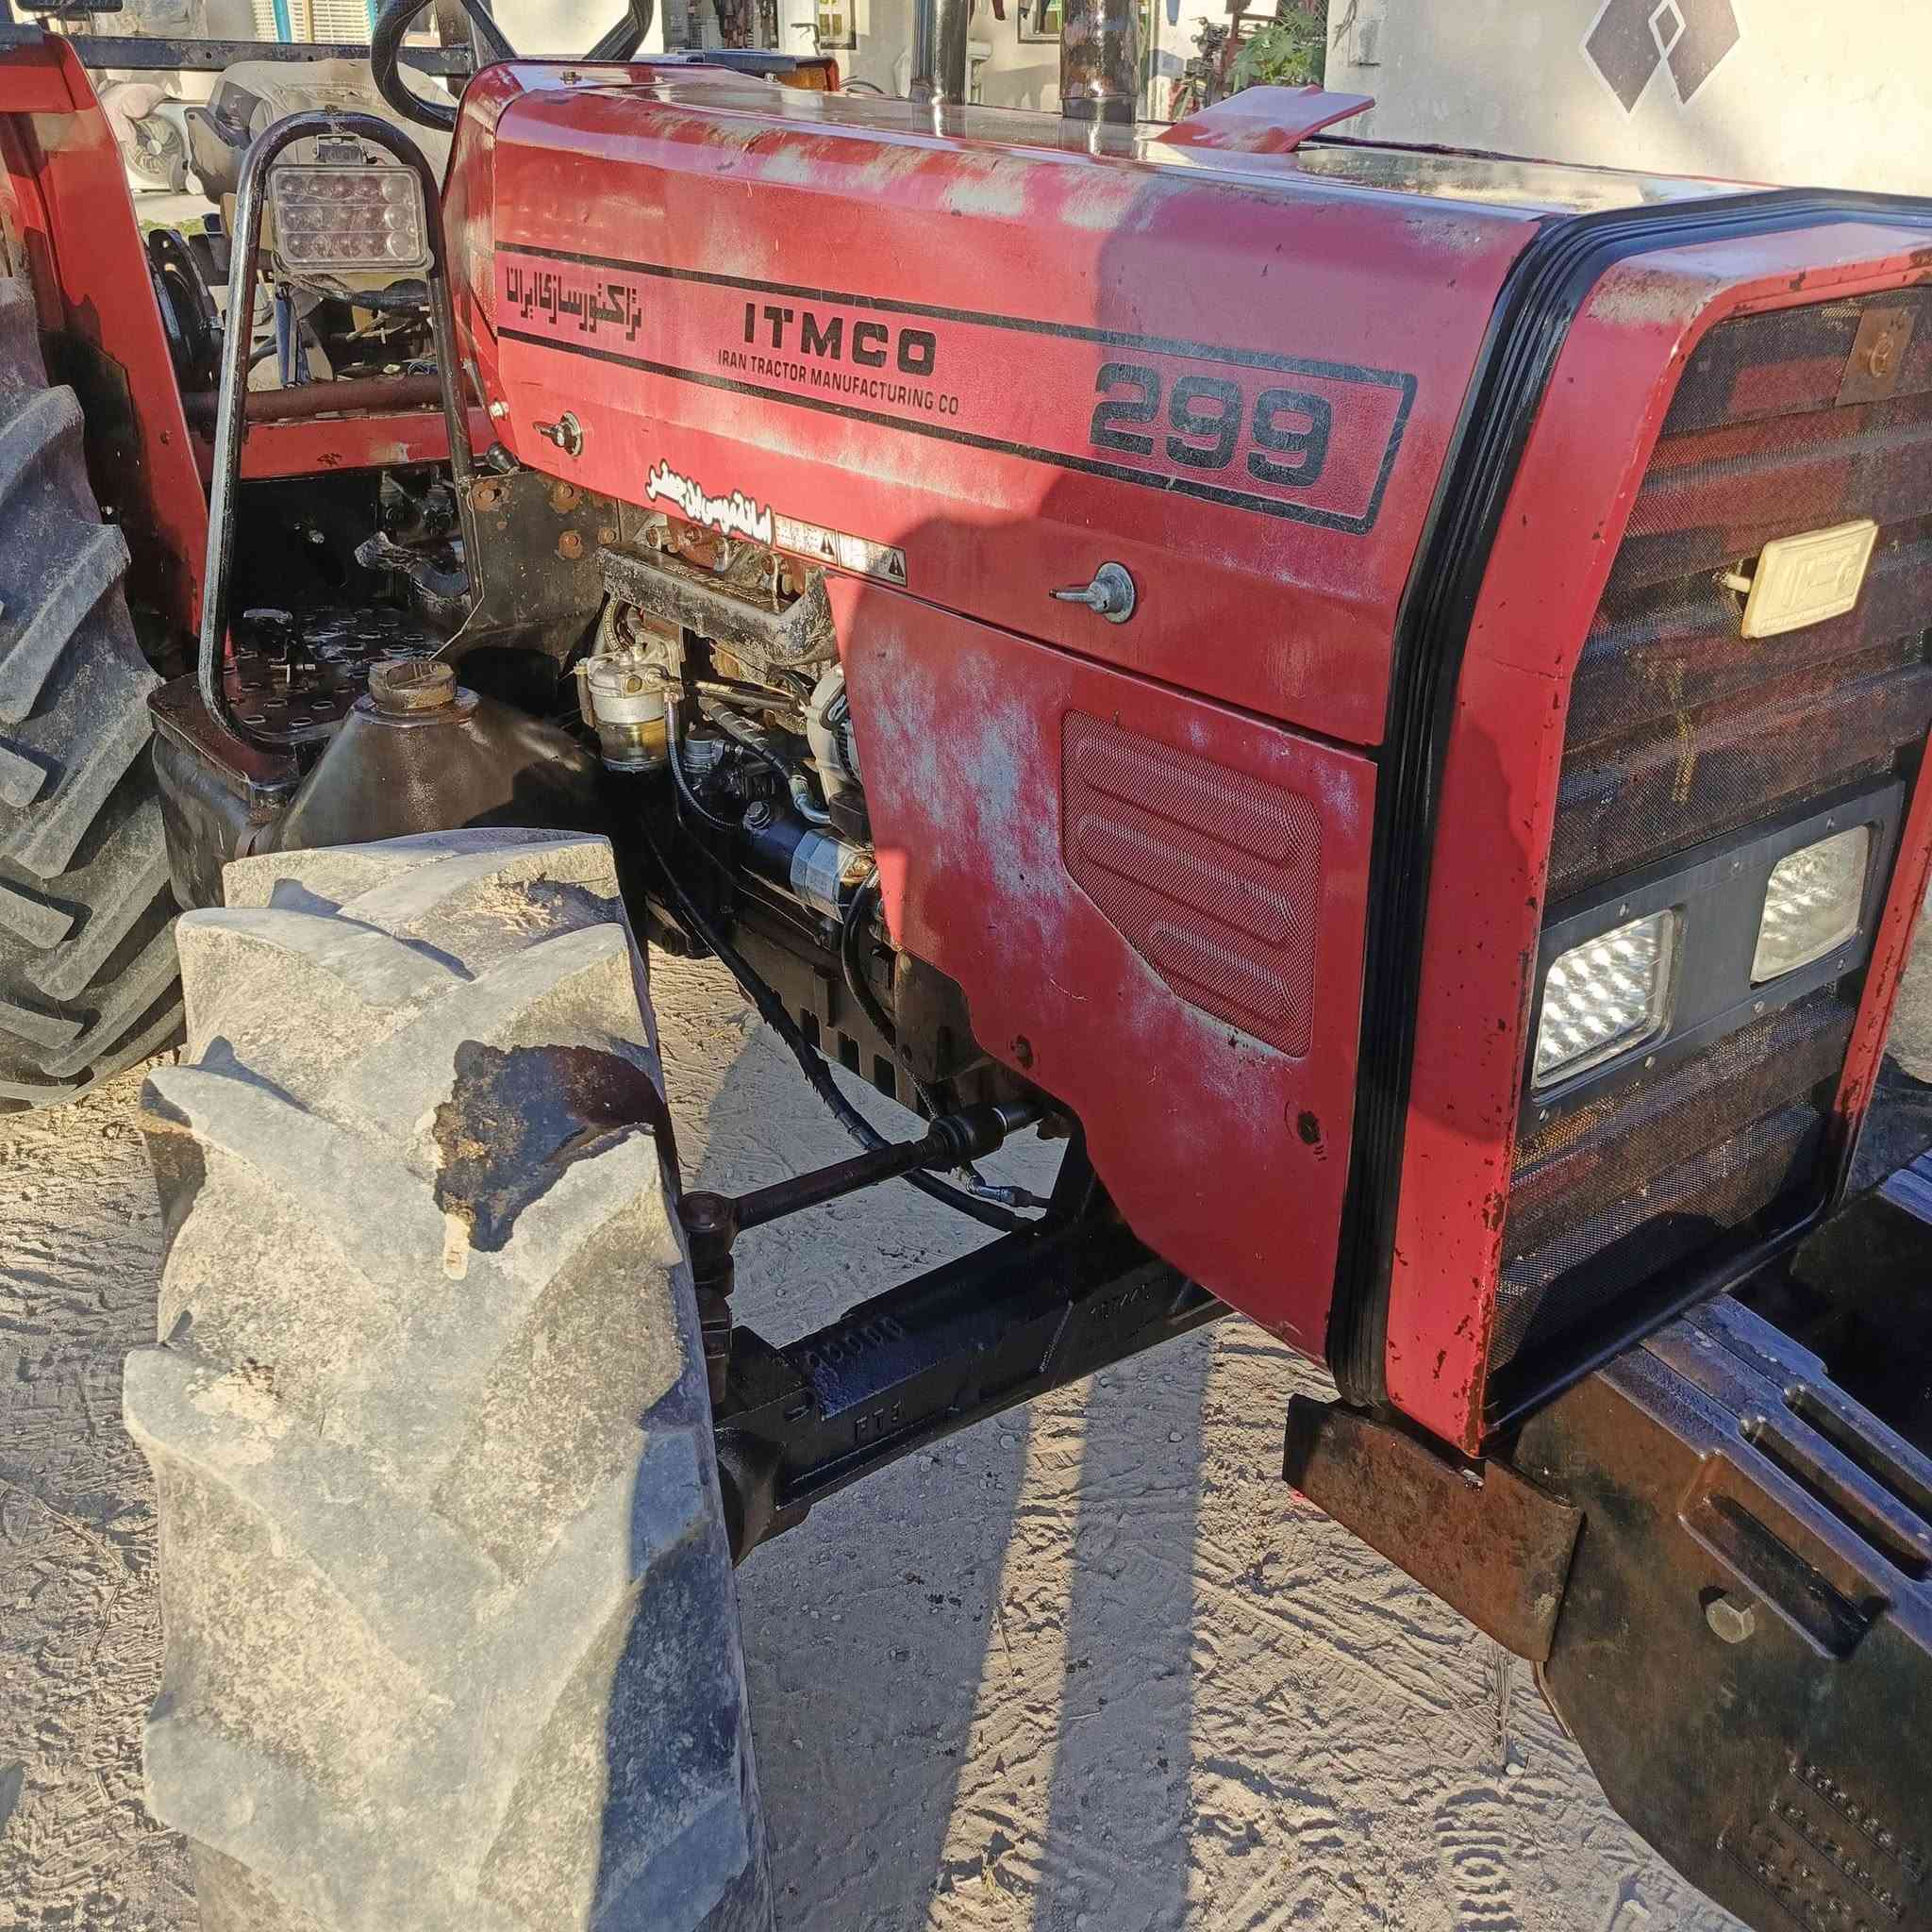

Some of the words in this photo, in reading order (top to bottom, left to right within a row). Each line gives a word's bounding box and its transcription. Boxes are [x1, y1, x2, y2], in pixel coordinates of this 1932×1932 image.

[743, 301, 938, 377] ITMCO
[717, 348, 747, 372] IRAN
[750, 355, 808, 385] TRACTOR
[809, 367, 935, 410] MANUFACTURING
[938, 392, 960, 416] CO
[1089, 361, 1334, 489] 299
